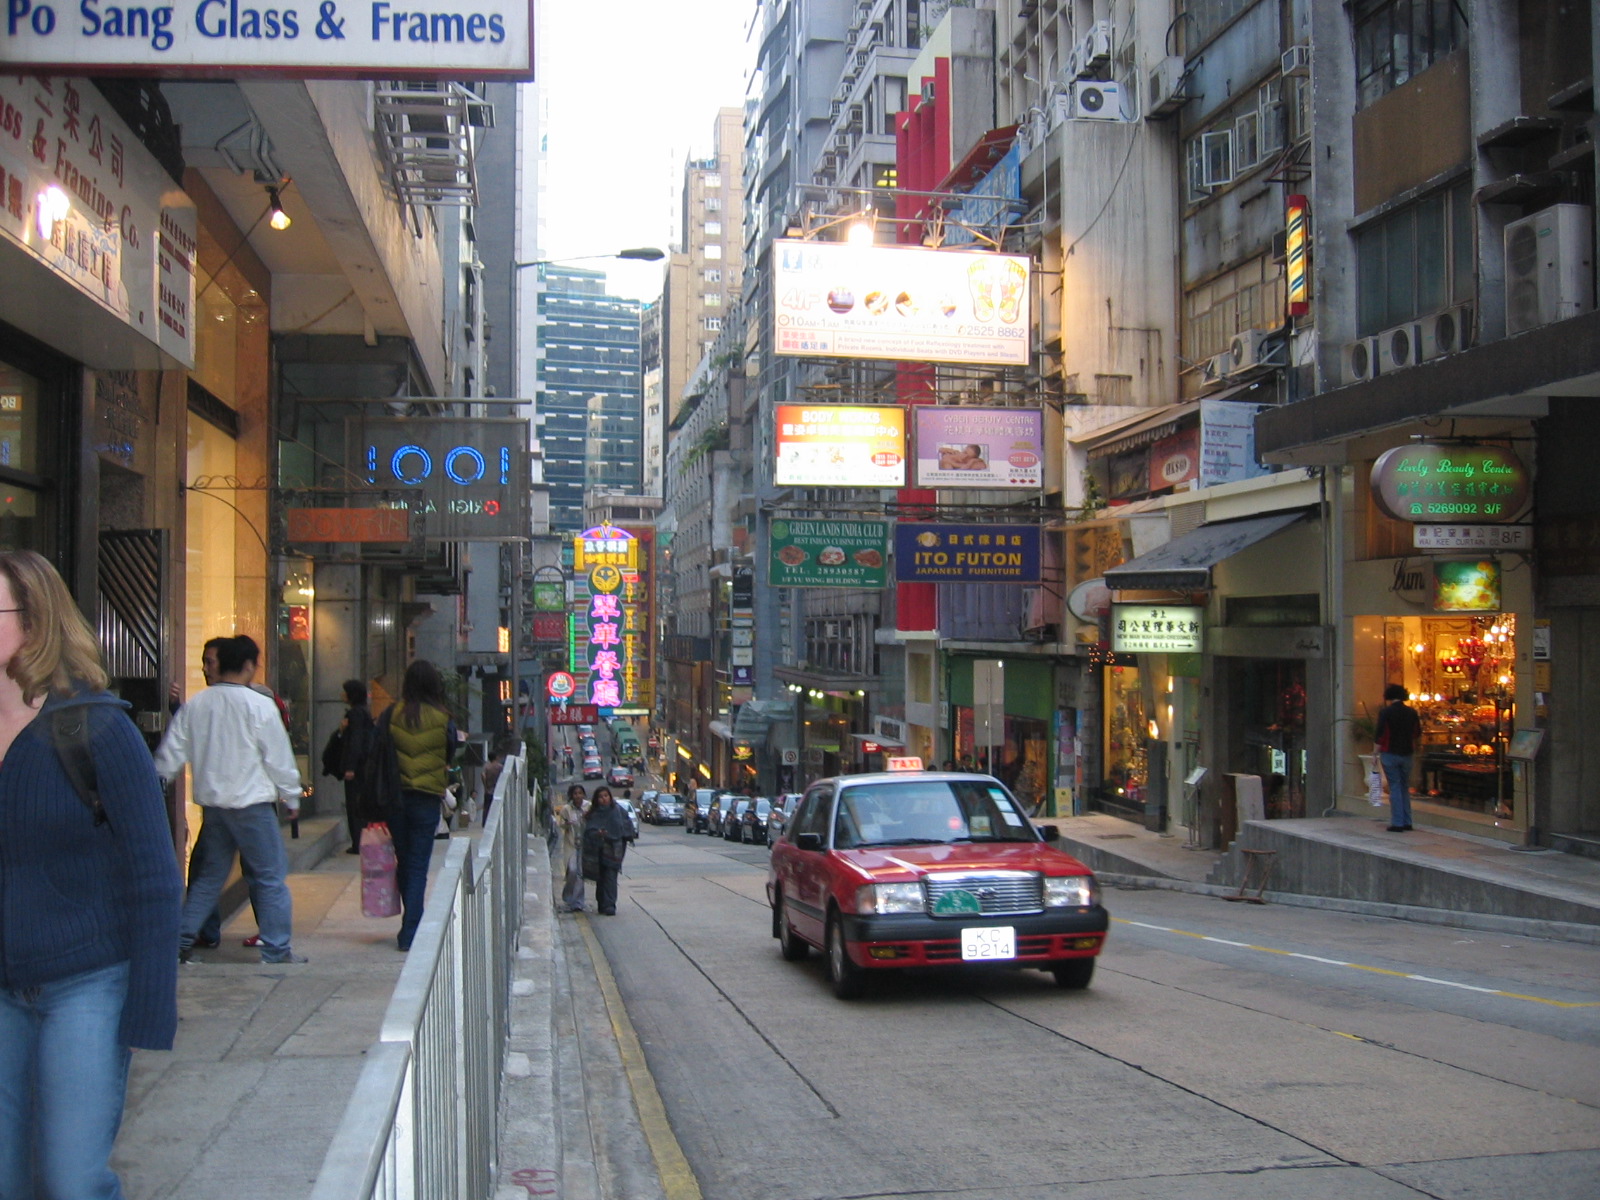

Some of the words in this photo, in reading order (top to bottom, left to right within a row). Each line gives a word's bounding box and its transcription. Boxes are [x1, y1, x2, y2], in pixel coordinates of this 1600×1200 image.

[8, 0, 56, 36] Po
[81, 0, 174, 50] Sang
[196, 0, 300, 40] Glass
[315, 1, 346, 40] &
[371, 1, 506, 44] Frames
[33, 118, 47, 164] &
[54, 136, 119, 235] Framing
[120, 204, 140, 250] Co.
[967, 325, 994, 337] 2525
[997, 326, 1025, 339] 8862
[803, 411, 834, 422] BODY
[839, 411, 880, 423] WORKS
[973, 414, 1002, 424] BEAUTY
[1005, 415, 1035, 425] CENTRE
[1397, 459, 1428, 477] Lovely
[1437, 459, 1475, 477] Beauty
[1482, 460, 1513, 474] Centre
[1428, 503, 1477, 514] 5269092
[1484, 503, 1502, 514] 3/F
[841, 523, 862, 537] INDIA
[863, 524, 883, 538] CLUB
[810, 537, 830, 545] INDIAN
[831, 538, 855, 546] CUISINE
[856, 538, 863, 546] IN
[864, 538, 882, 546] TOWN
[1502, 531, 1521, 544] 8/F
[914, 551, 948, 566] ITO
[956, 552, 1022, 566] FUTON
[915, 567, 963, 575] JAPANESE
[969, 567, 1021, 575] FURNITURE
[826, 577, 861, 585] BUILDING
[591, 594, 621, 707] 翠華餐廳
[892, 759, 920, 769] TAXI
[967, 944, 1010, 957] 9214
